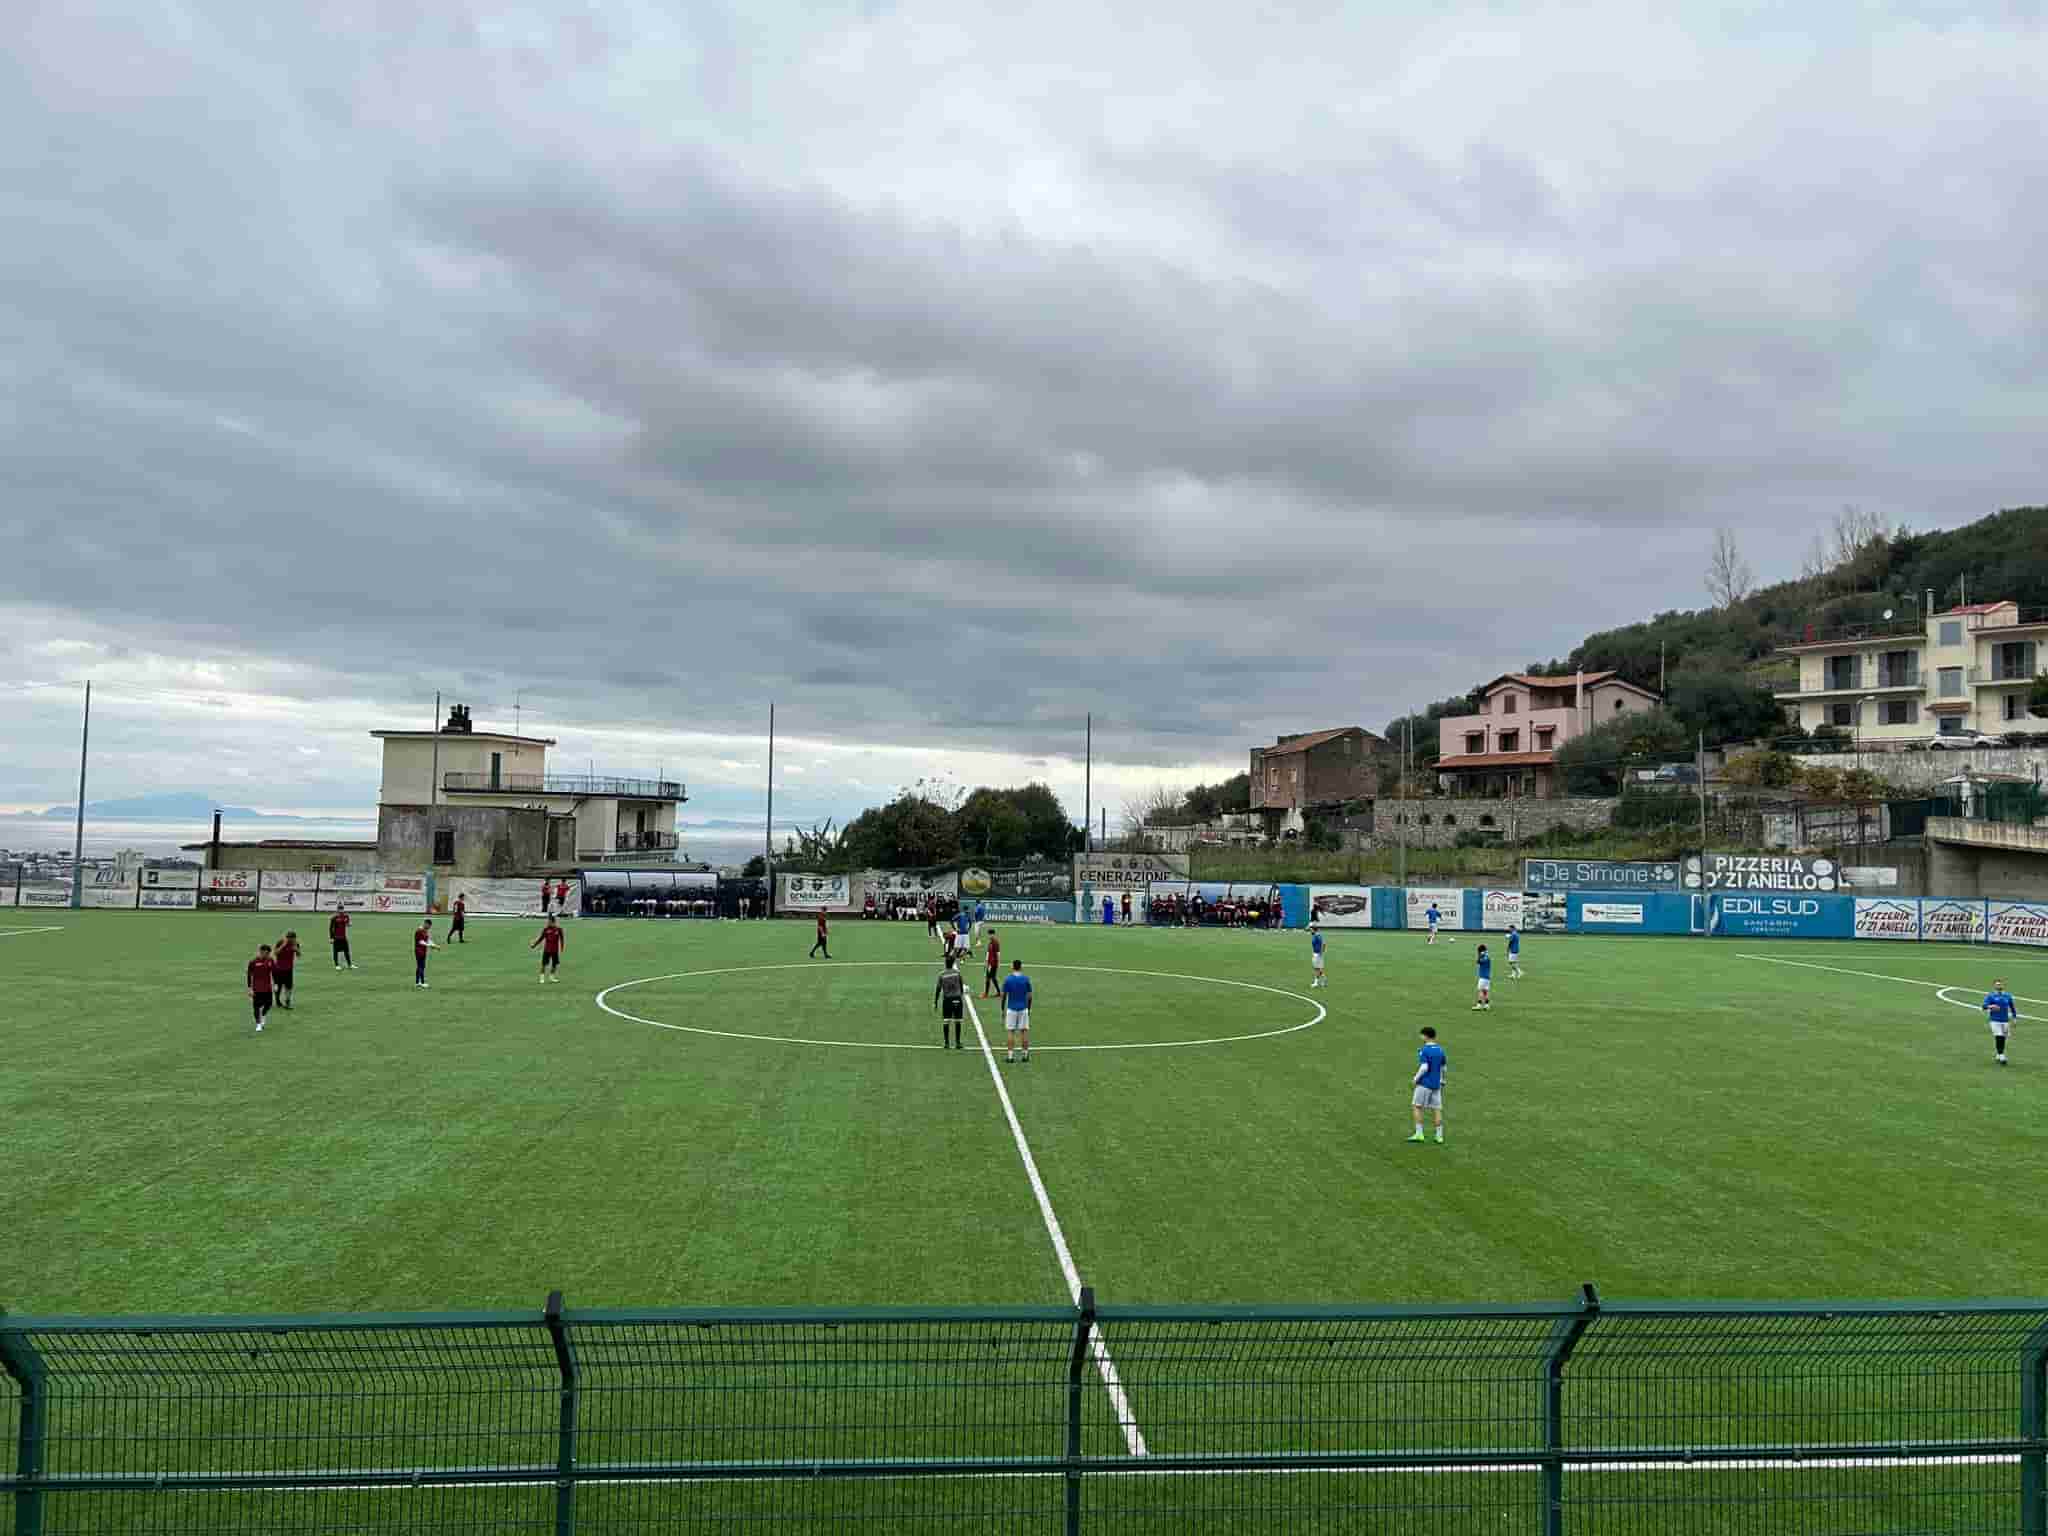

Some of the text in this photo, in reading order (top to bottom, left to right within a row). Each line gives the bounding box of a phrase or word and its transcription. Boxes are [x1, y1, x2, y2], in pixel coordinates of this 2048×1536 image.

[1716, 857, 1804, 873] PIZZERIA
[1576, 864, 1648, 882] Simone
[1725, 873, 1742, 888] ZI
[1747, 874, 1817, 890] ANIELLO
[983, 913, 1014, 921] UNIOR
[1865, 912, 1910, 921] PIZZERIA
[1997, 915, 2048, 926] PIZZERIA
[1879, 921, 1917, 932] ANIELLO
[2012, 926, 2048, 937] ANIELL
